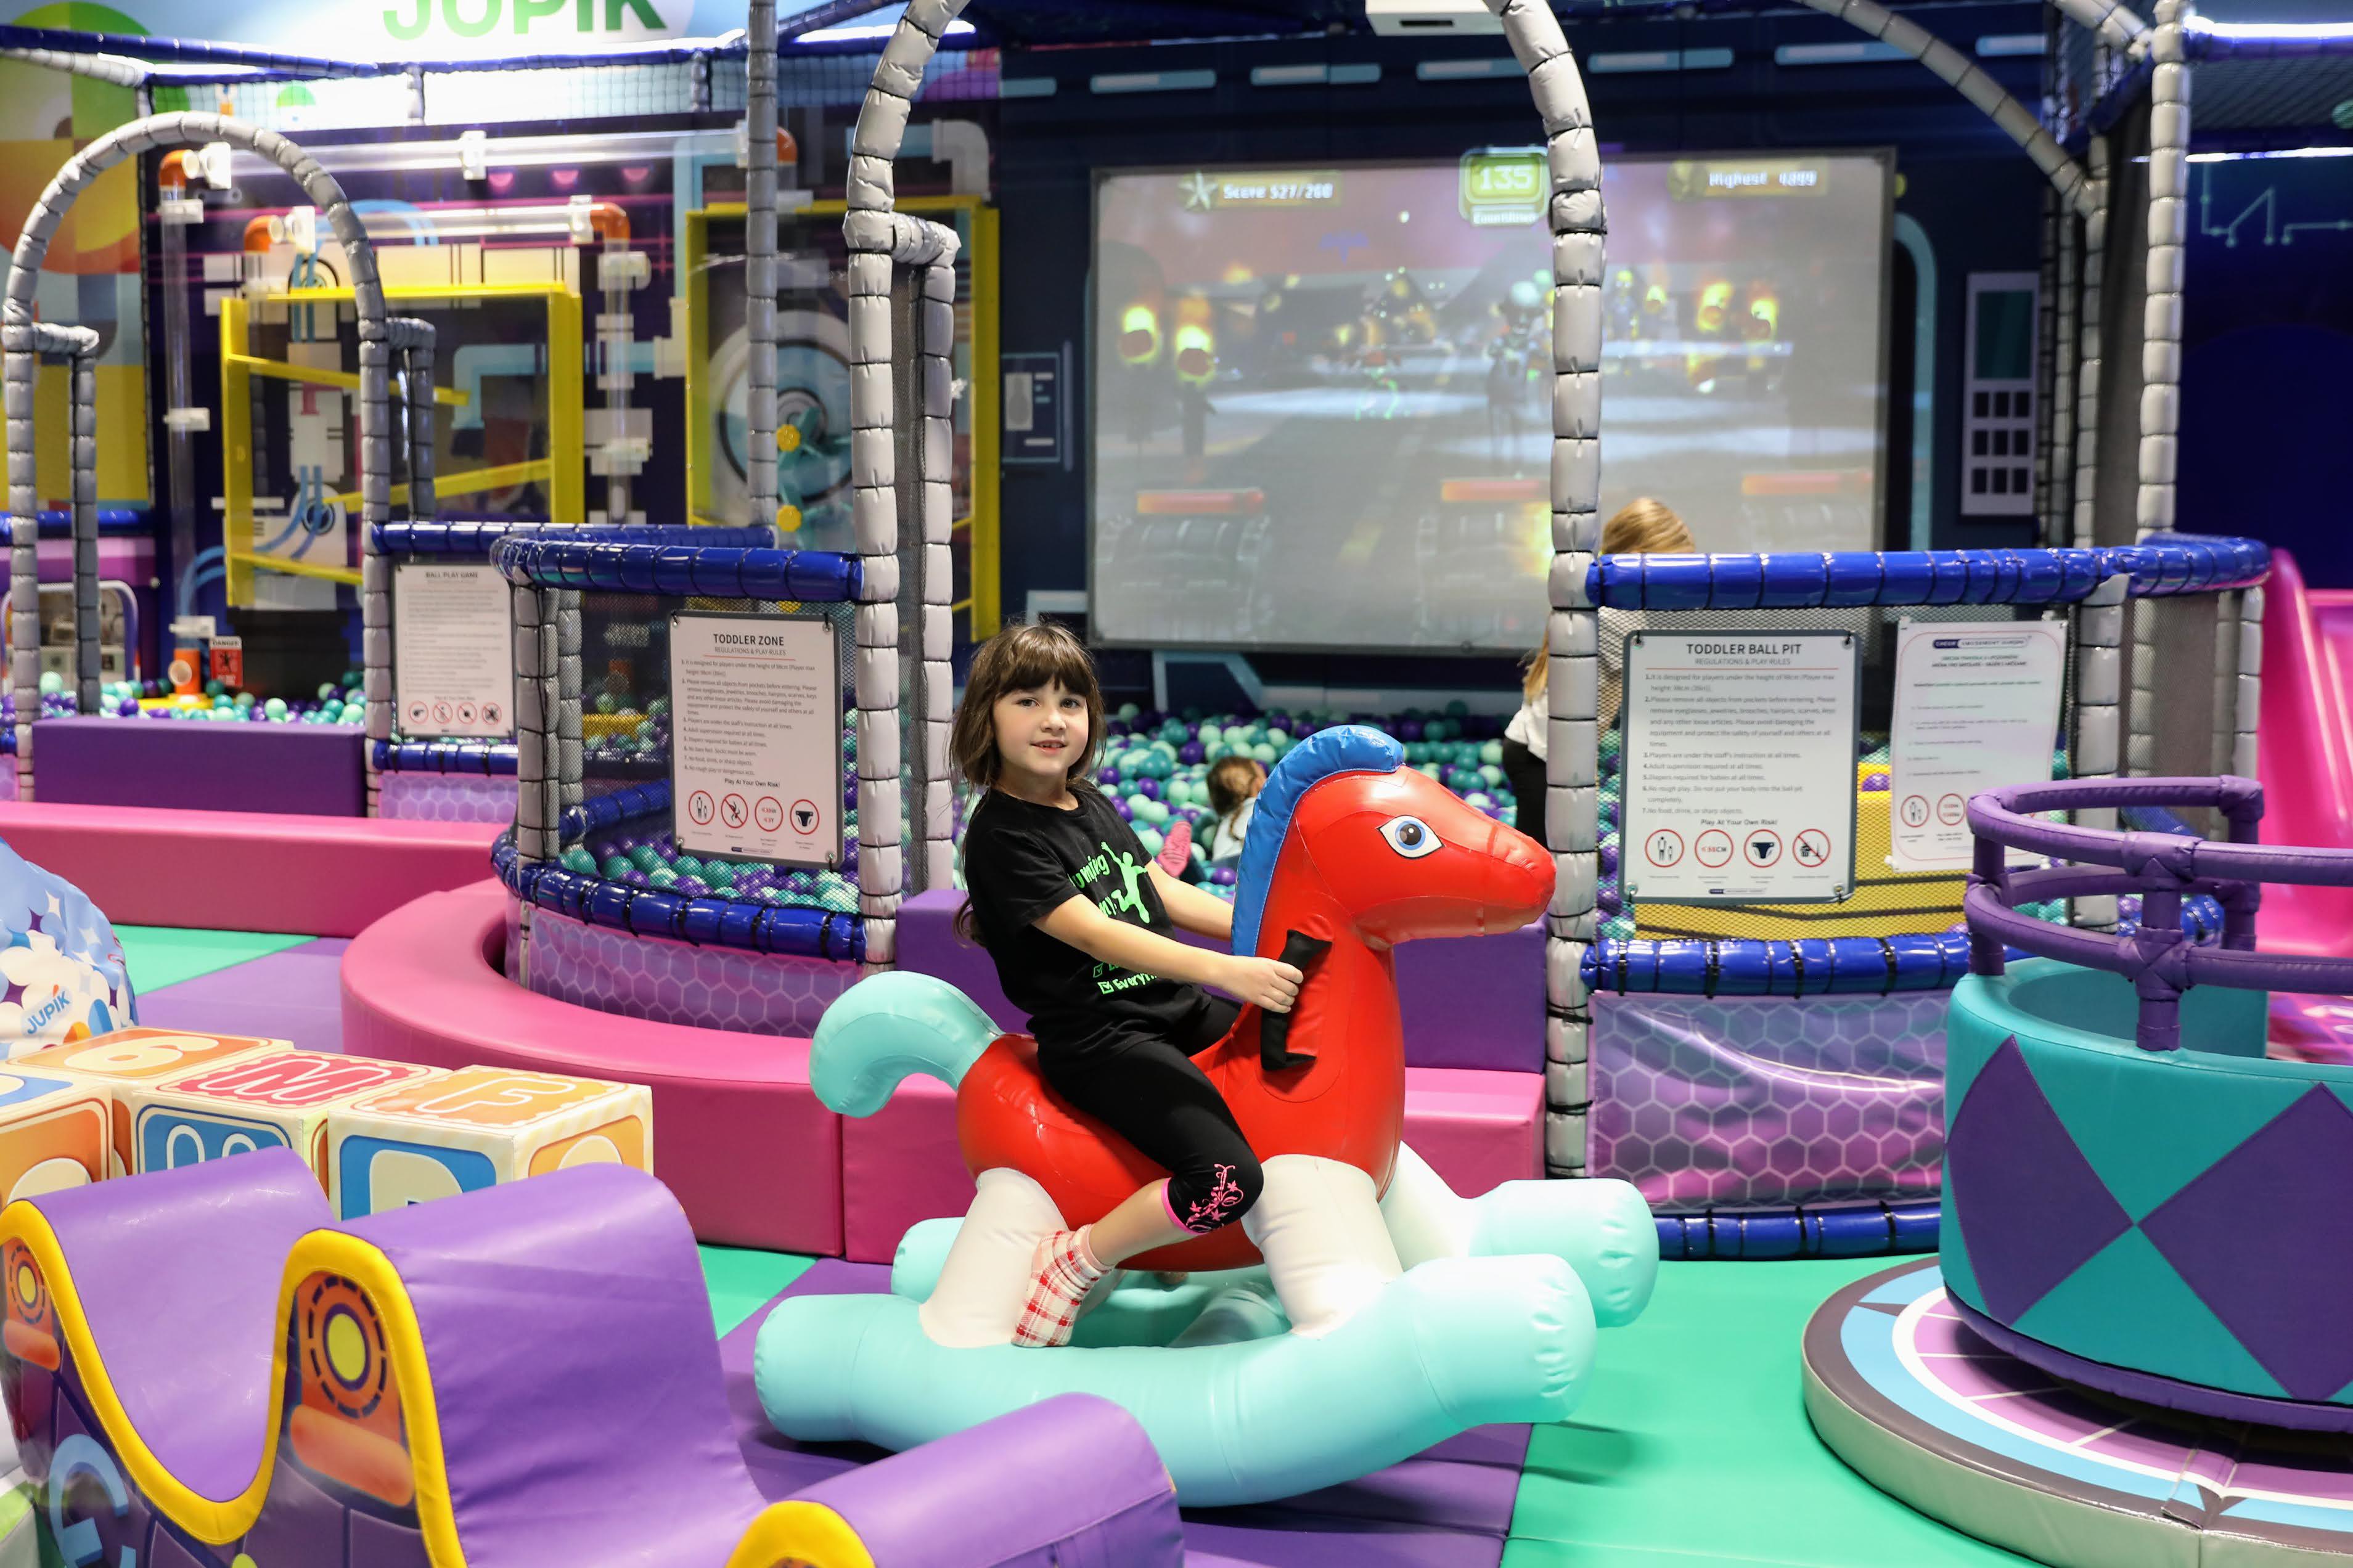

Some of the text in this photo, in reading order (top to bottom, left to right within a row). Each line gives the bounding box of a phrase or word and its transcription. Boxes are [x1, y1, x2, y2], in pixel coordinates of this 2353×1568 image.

[1479, 165, 1533, 190] 135
[1709, 171, 1767, 189] Highest
[1223, 183, 1267, 198] Score
[713, 634, 785, 647] TODDLER ZONE
[1686, 644, 1802, 654] TODDLER BALL PIT
[197, 1058, 392, 1101] M
[415, 1077, 576, 1114] F
